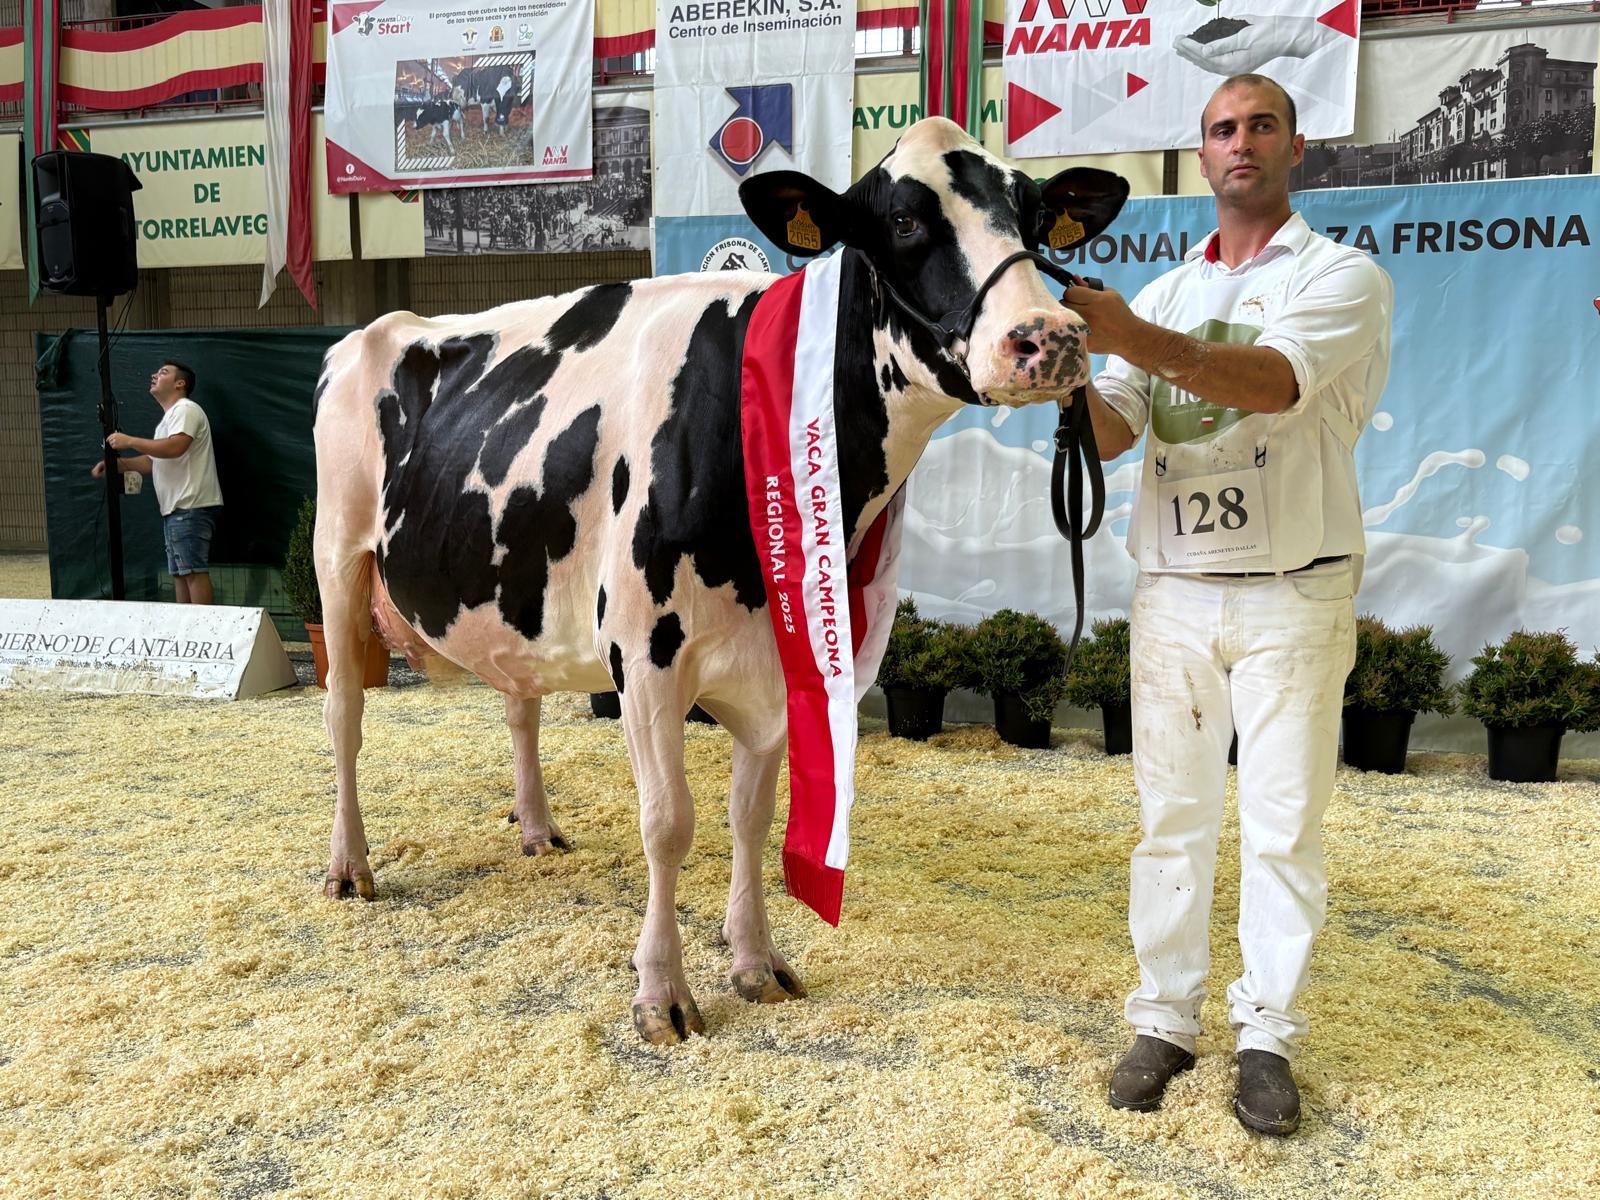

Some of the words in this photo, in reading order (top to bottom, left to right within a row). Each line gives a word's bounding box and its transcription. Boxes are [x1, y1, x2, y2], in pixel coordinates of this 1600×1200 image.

[435, 11, 466, 20] programa
[468, 9, 479, 17] que
[499, 5, 516, 13] todas
[528, 1, 567, 10] necesidades
[518, 10, 549, 18] transición
[670, 0, 791, 23] ABEREKIN,
[798, 0, 842, 12] S.A.
[378, 22, 411, 35] Start
[669, 26, 717, 39] Centro
[721, 22, 739, 35] de
[743, 13, 842, 33] Inseminación
[1006, 18, 1151, 56] NANTA
[120, 144, 265, 173] AYUNTAMIEN
[542, 156, 568, 165] NANTA
[194, 182, 221, 204] DE
[135, 213, 268, 240] TORRELAVEG
[789, 230, 818, 248] 2055
[1051, 231, 1082, 248] 2055
[1391, 214, 1591, 255] FRISONA
[715, 240, 747, 253] FRISONA
[748, 243, 759, 254] DE
[806, 417, 822, 477] VACA
[810, 485, 830, 546] GRAN
[1170, 486, 1249, 537] 128
[766, 475, 785, 584] REGIONAL
[777, 591, 796, 634] 2025
[818, 554, 842, 678] CAMPEONA
[0, 632, 69, 653] IERNO
[72, 635, 105, 654] DE
[108, 636, 235, 660] CANTABRIA
